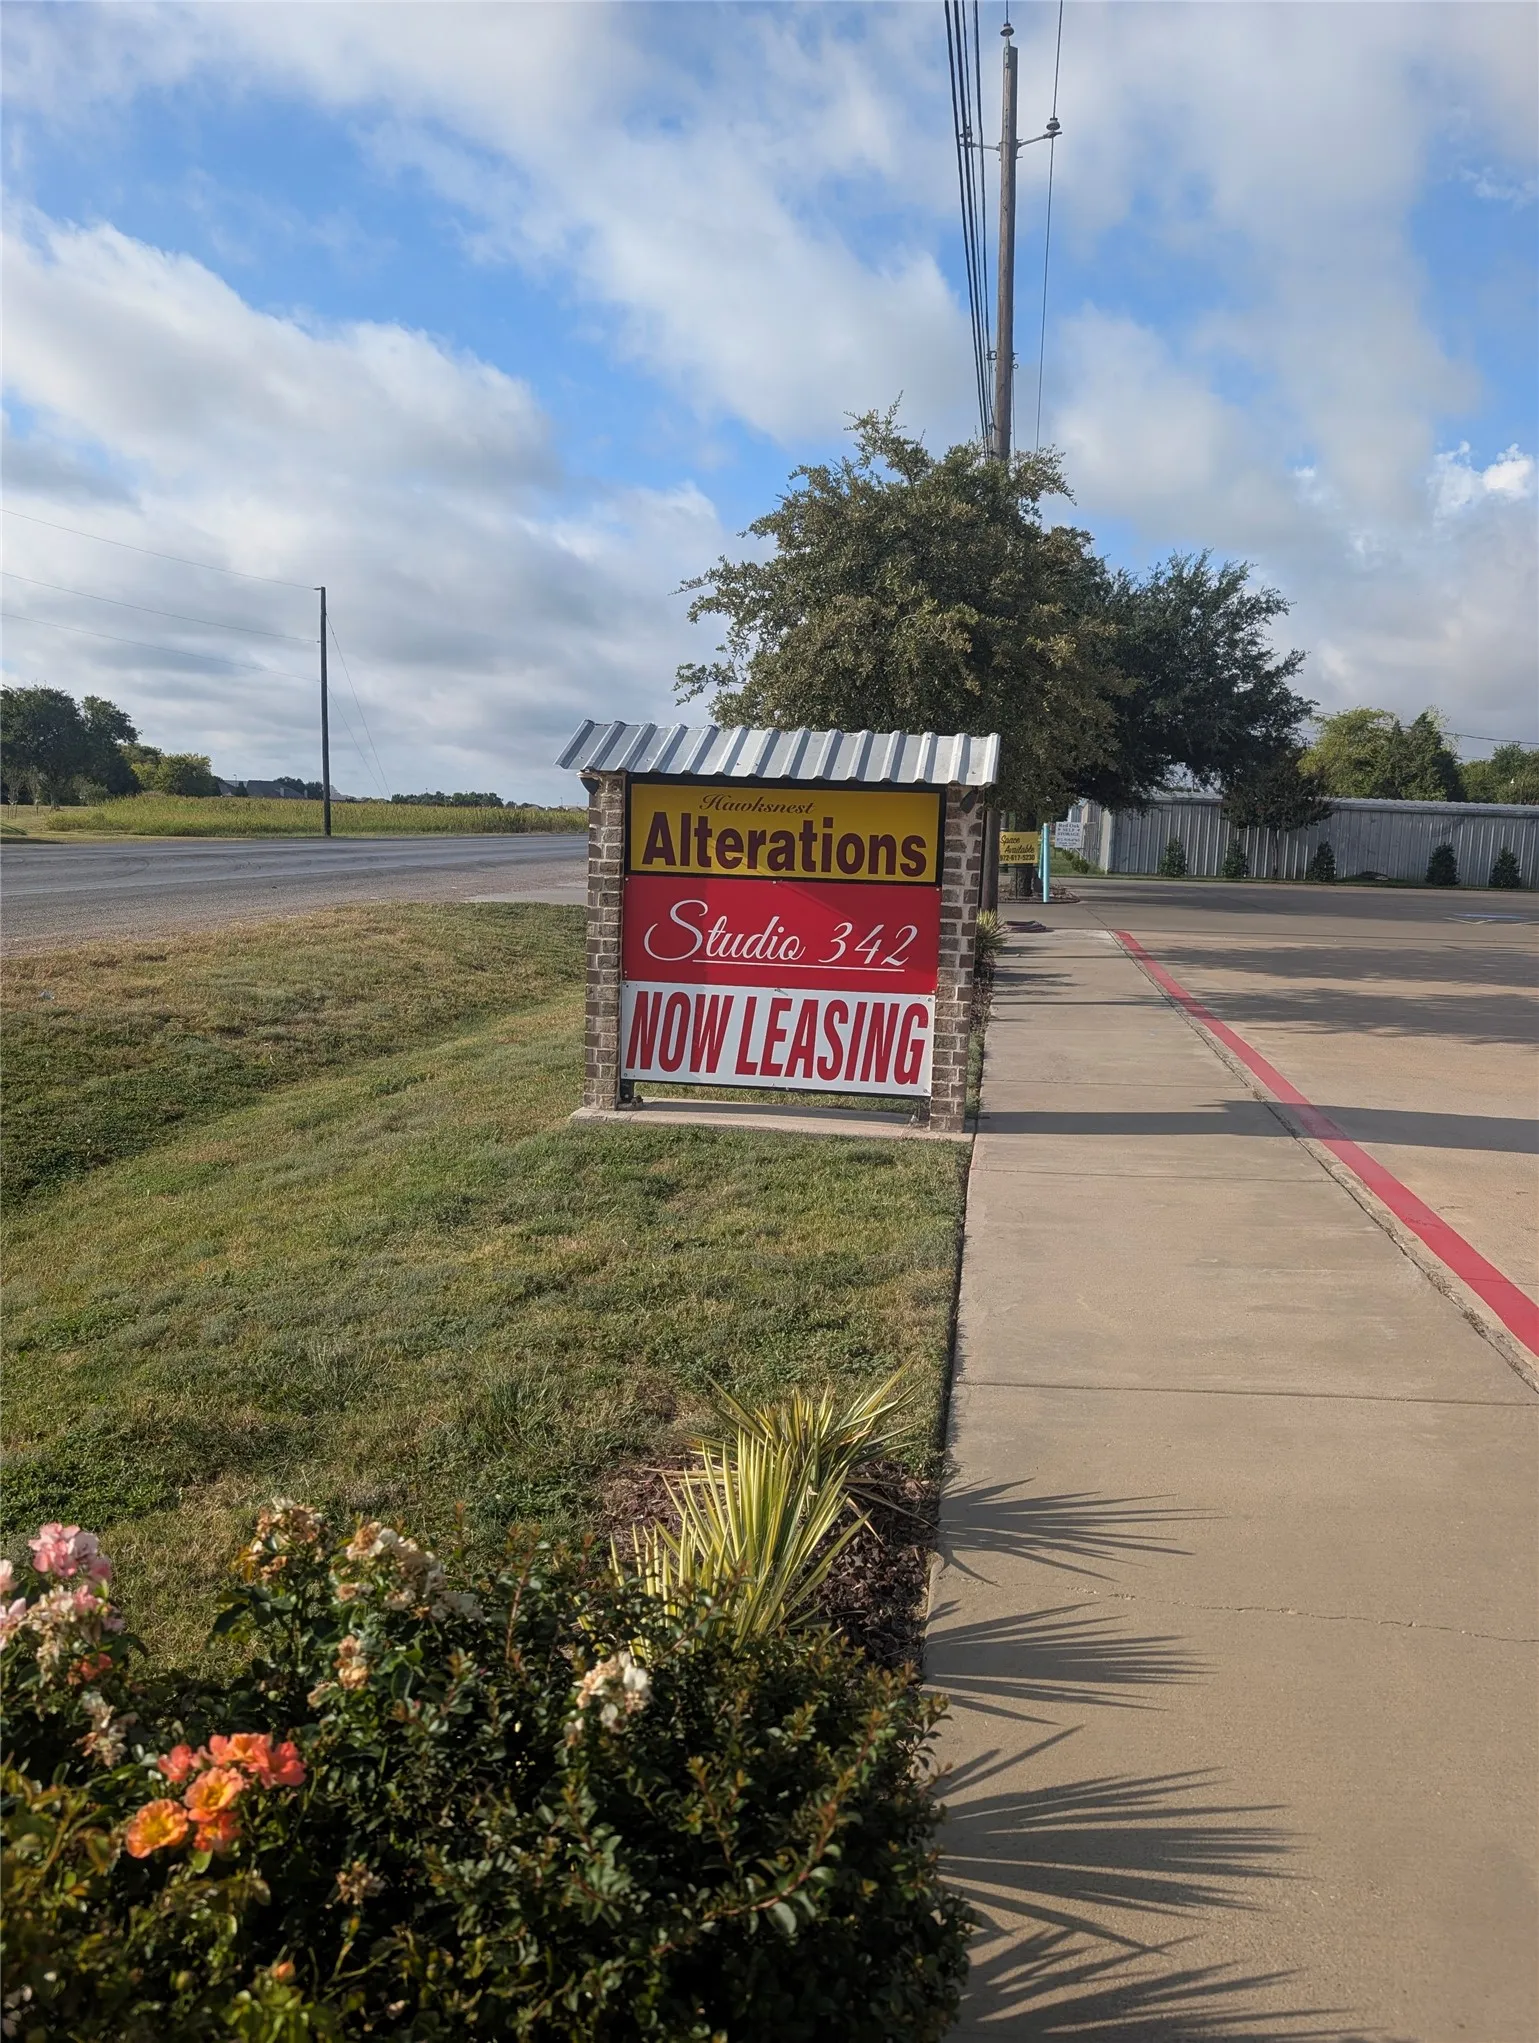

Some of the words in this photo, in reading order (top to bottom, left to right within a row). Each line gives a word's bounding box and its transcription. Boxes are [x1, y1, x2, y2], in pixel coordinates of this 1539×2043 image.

[698, 794, 816, 815] Hawksnest
[641, 811, 927, 877] Alterations
[1000, 835, 1020, 846] Space
[1004, 844, 1035, 853] Available
[644, 899, 806, 961] Studio
[818, 922, 919, 966] 342
[625, 990, 735, 1074] NOW
[735, 996, 929, 1086] LEASING
